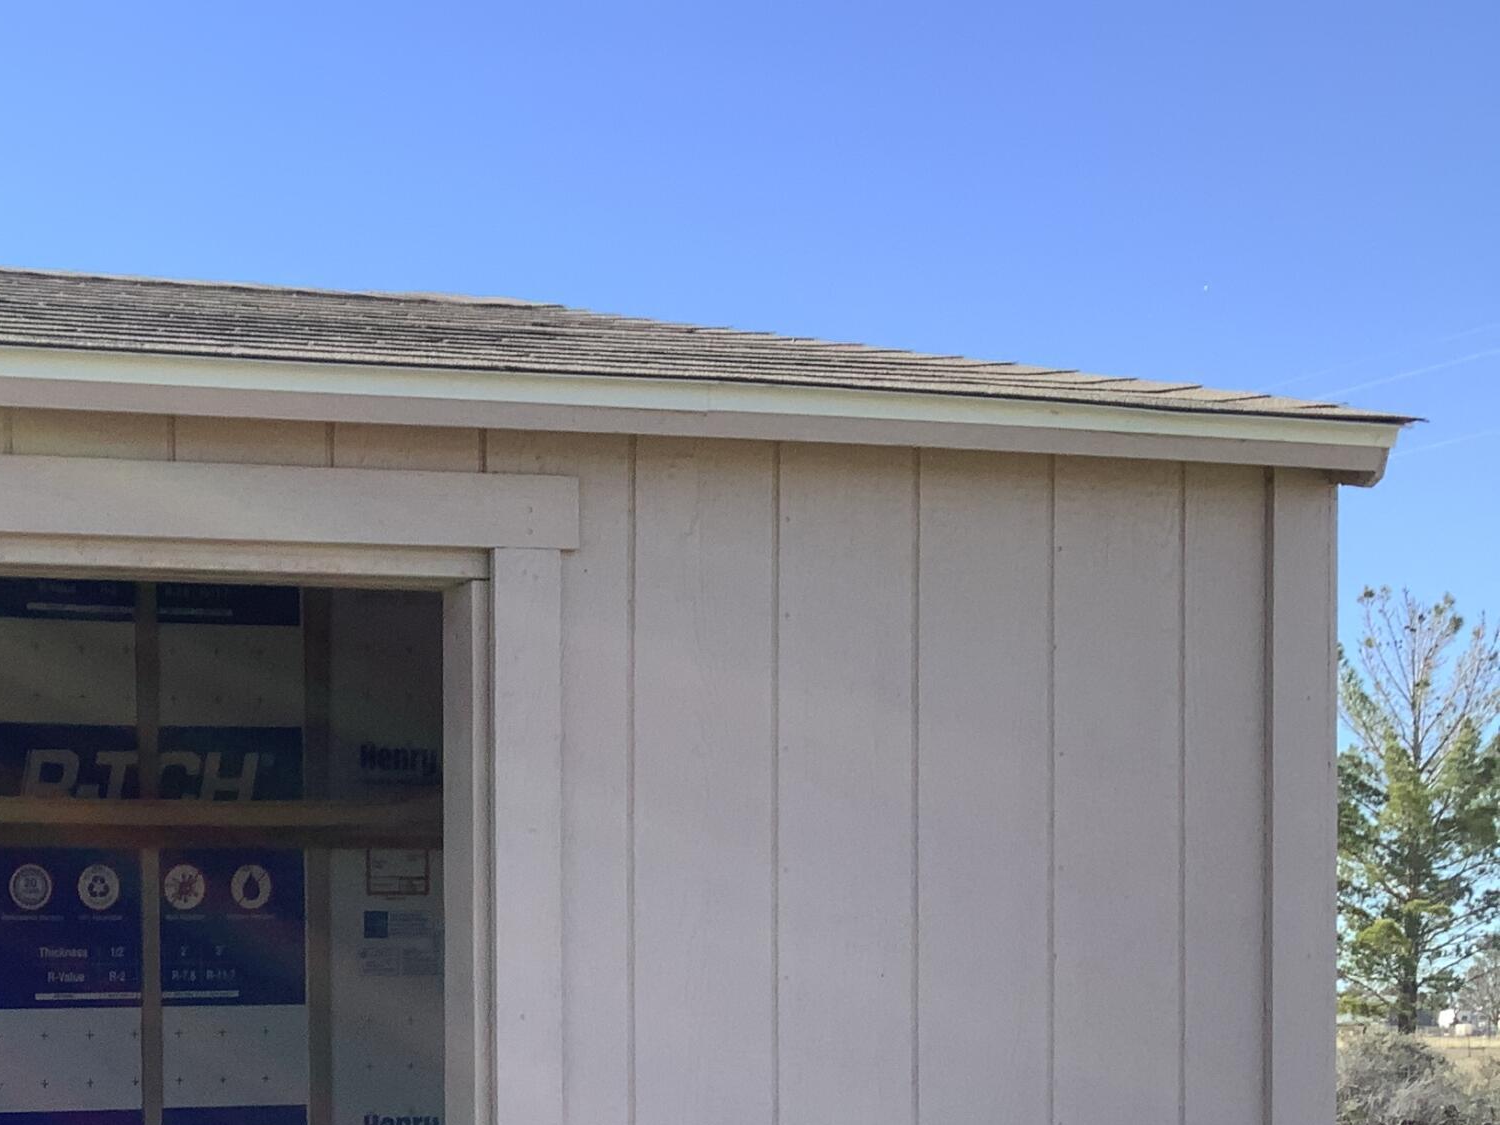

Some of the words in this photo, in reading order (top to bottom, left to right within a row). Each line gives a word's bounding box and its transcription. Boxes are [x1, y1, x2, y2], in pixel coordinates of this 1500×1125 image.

[360, 743, 438, 775] Henry
[24, 876, 38, 888] 20
[39, 946, 89, 959] Thickness
[47, 970, 86, 983] R-Value
[109, 970, 126, 982] R-2
